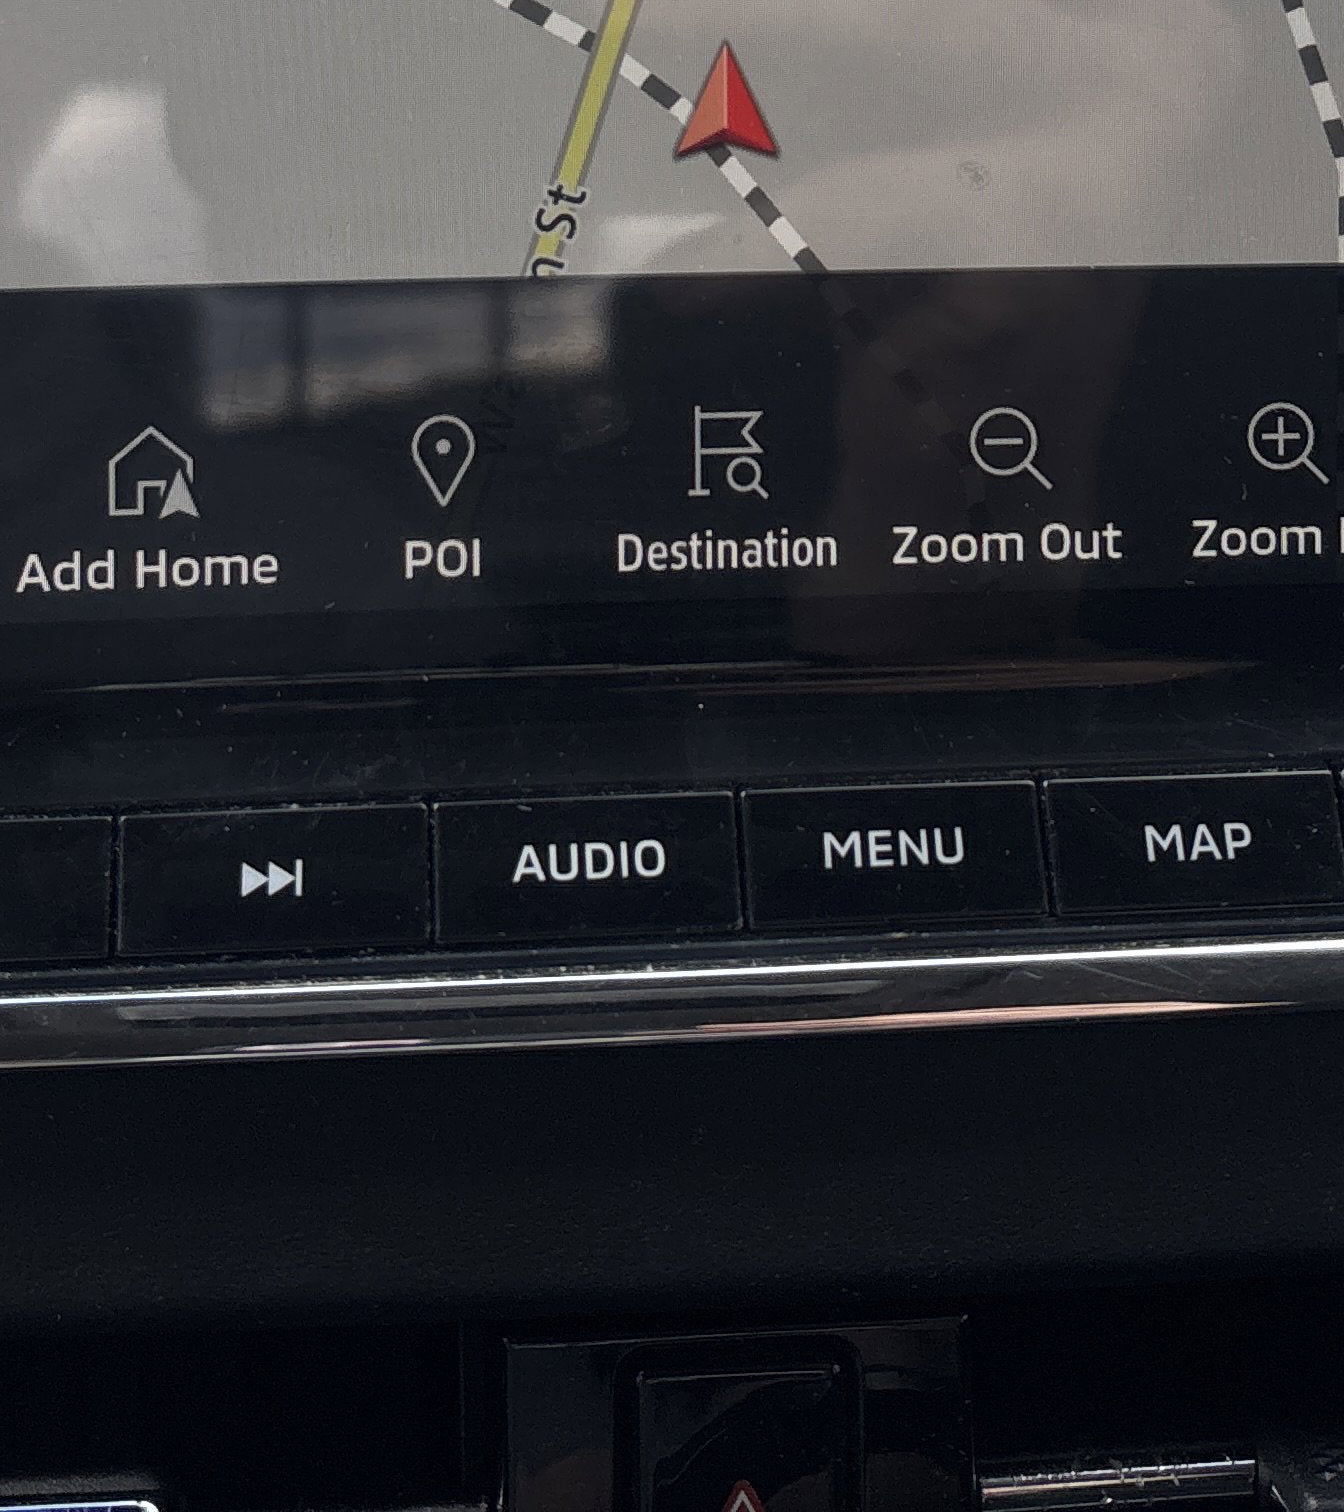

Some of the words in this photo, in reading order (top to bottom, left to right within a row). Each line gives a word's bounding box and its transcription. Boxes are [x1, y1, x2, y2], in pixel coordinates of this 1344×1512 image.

[533, 183, 587, 240] St
[403, 537, 482, 580] POI
[617, 527, 839, 574] Destination
[891, 524, 1025, 566] Zoom
[1039, 521, 1124, 561] Out
[1190, 518, 1322, 558] Zoom
[16, 551, 115, 593] Add
[135, 549, 279, 590] Home
[511, 838, 667, 884] AUDIO
[822, 826, 965, 870] MENU
[1143, 821, 1253, 863] MAP
